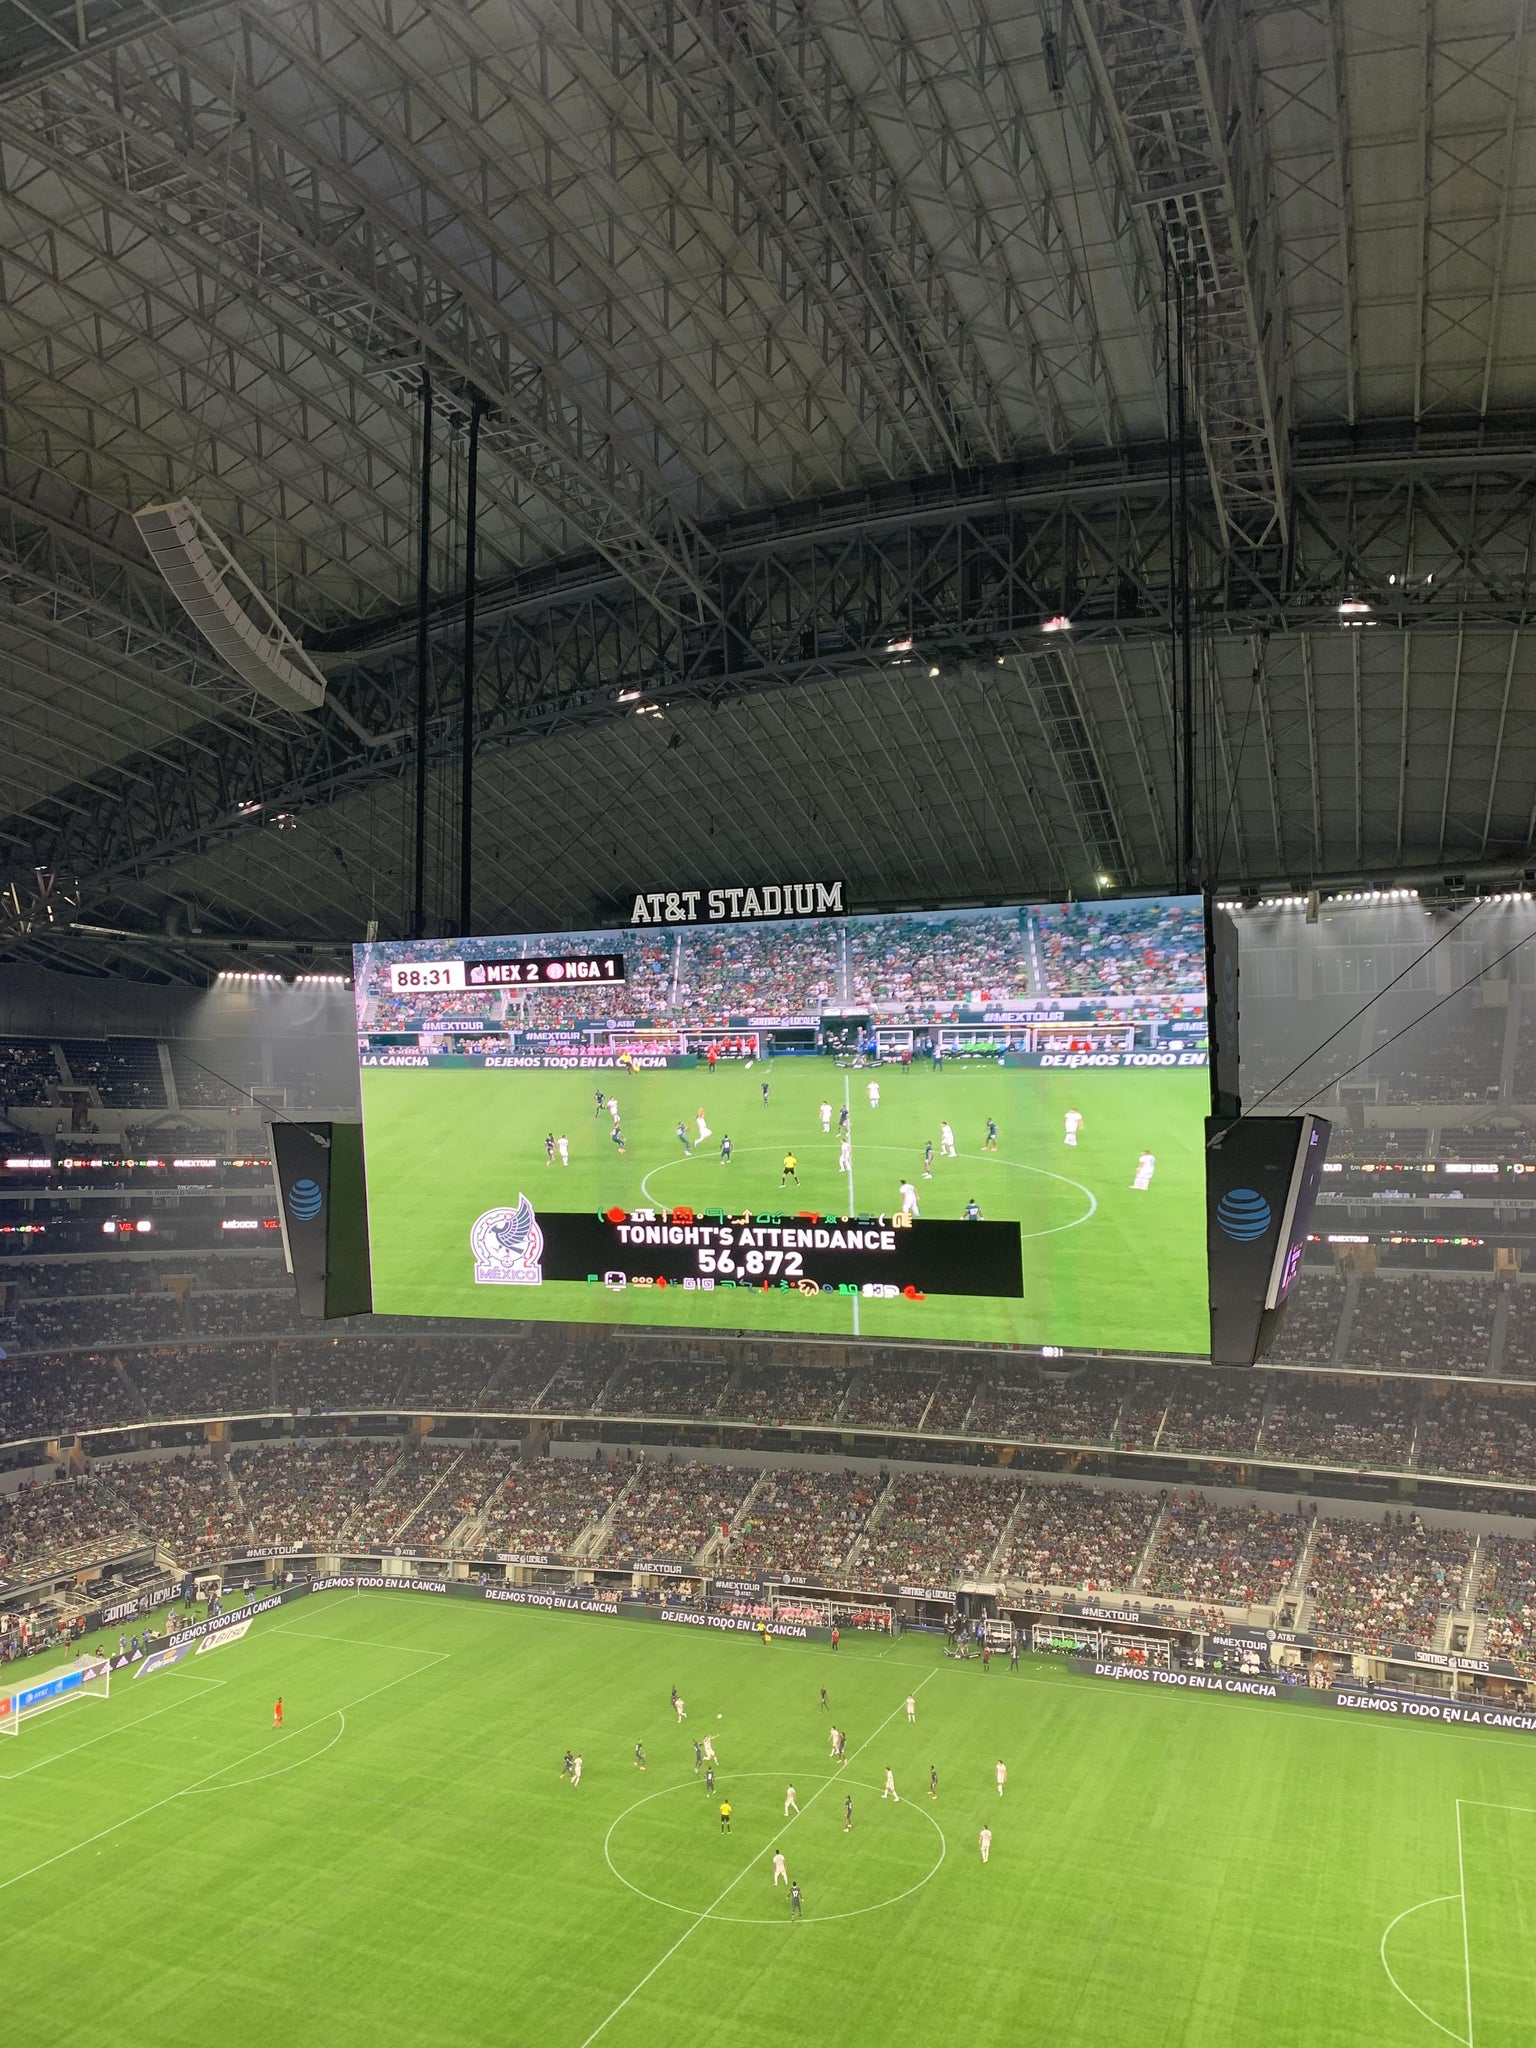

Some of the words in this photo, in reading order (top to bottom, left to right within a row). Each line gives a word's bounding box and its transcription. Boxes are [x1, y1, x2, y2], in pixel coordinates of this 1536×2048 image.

[630, 890, 701, 924] AT&T
[708, 881, 843, 919] STADIUM
[397, 968, 451, 987] 88:31
[487, 964, 521, 983] MEX
[526, 963, 539, 981] 2
[565, 960, 600, 979] NGA
[604, 959, 615, 977] 1
[616, 1020, 636, 1028] AT&T
[983, 1011, 1065, 1022] #MEXTOUR
[422, 1021, 484, 1031] #MEXTOUR
[525, 1032, 580, 1041] #MEXTOUR
[362, 1056, 376, 1066] LA
[380, 1056, 430, 1066] CANCHA
[485, 1057, 541, 1067] DEJEMOS
[543, 1057, 577, 1068] TODO
[579, 1057, 599, 1067] EN
[599, 1057, 614, 1067] LA
[615, 1057, 668, 1068] CNCHA
[1040, 1053, 1120, 1067] DEJEMOS
[1123, 1053, 1177, 1066] TODO
[1177, 1053, 1206, 1065] EN
[617, 1225, 734, 1246] TONIGHT'S
[739, 1227, 897, 1250] ATTENDANCE
[698, 1249, 804, 1279] 56,872
[480, 1266, 537, 1281] MÉXICO
[246, 1545, 298, 1558] #MEXTOUR
[633, 1562, 682, 1574] #MEXTOUR
[312, 1577, 355, 1592] DEJEMOS
[357, 1577, 384, 1587] TODO
[385, 1578, 398, 1588] EN
[398, 1580, 411, 1589] LA
[411, 1581, 446, 1593] CANCHA
[715, 1580, 760, 1592] #MEXTOUR
[791, 1576, 807, 1585] AT&T
[485, 1589, 526, 1603] DEJEMOS
[527, 1594, 553, 1606] TODO
[554, 1599, 566, 1608] EN
[567, 1600, 579, 1610] LA
[580, 1601, 618, 1614] CANCHA
[169, 1625, 207, 1647] DEJEMOS
[208, 1617, 231, 1632] TODO
[230, 1613, 242, 1623] EN
[242, 1608, 252, 1618] LA
[252, 1596, 282, 1614] CANCHA
[1081, 1606, 1140, 1623] #MEXTOUR
[661, 1610, 705, 1625] DEJEMOS
[707, 1616, 736, 1629] TODO
[737, 1619, 750, 1630] EN
[766, 1623, 807, 1638] CANCHA
[1212, 1636, 1268, 1651] #MEXTOUR
[1277, 1633, 1296, 1642] AT&T
[1095, 1664, 1150, 1681] DEJEMOS
[1152, 1670, 1187, 1685] TODO
[1188, 1674, 1206, 1688] EN
[1207, 1677, 1224, 1690] LA
[1225, 1680, 1277, 1697] CANCHA
[1337, 1694, 1398, 1712] DEJEMOS
[1401, 1702, 1441, 1718] TODO
[1443, 1708, 1461, 1720] EN
[1463, 1709, 1481, 1724] LA
